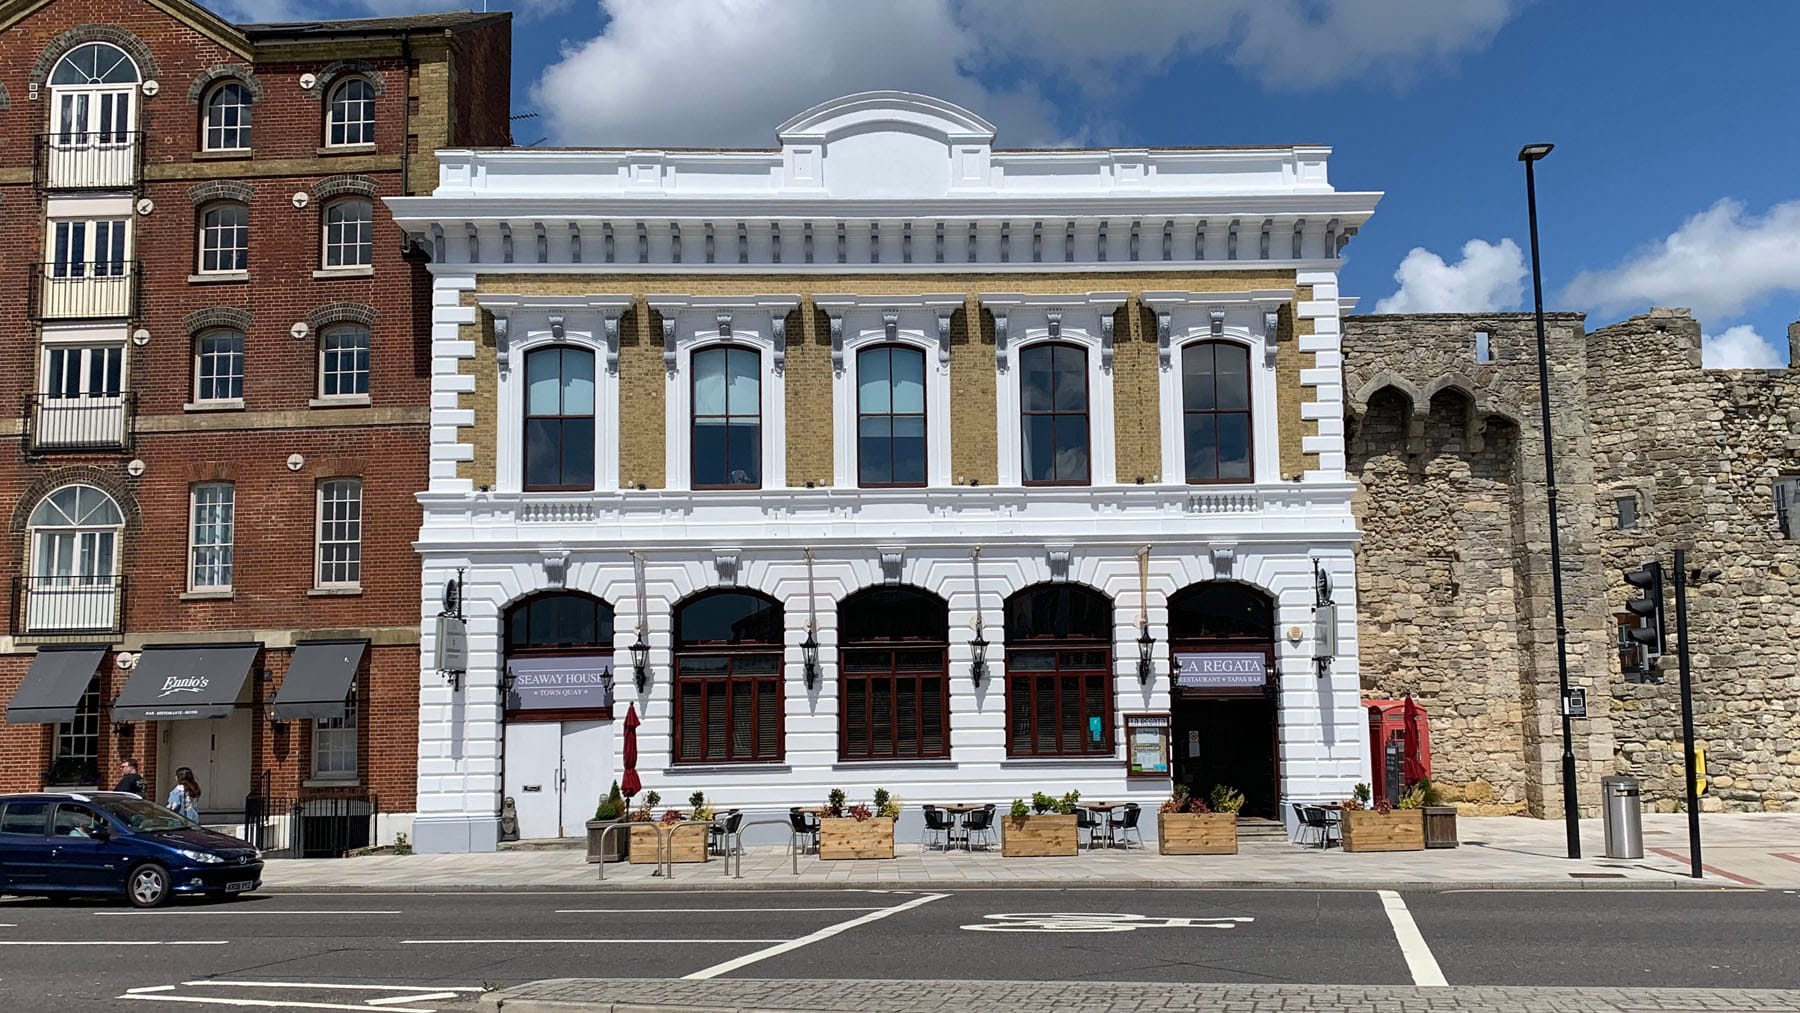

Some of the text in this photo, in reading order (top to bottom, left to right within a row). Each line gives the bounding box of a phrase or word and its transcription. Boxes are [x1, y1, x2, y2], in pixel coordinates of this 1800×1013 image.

[1179, 660, 1261, 672] LA REGATA
[160, 676, 209, 691] Ennio's
[518, 674, 565, 685] SEAWAY
[540, 689, 583, 697] TOWN QUAY
